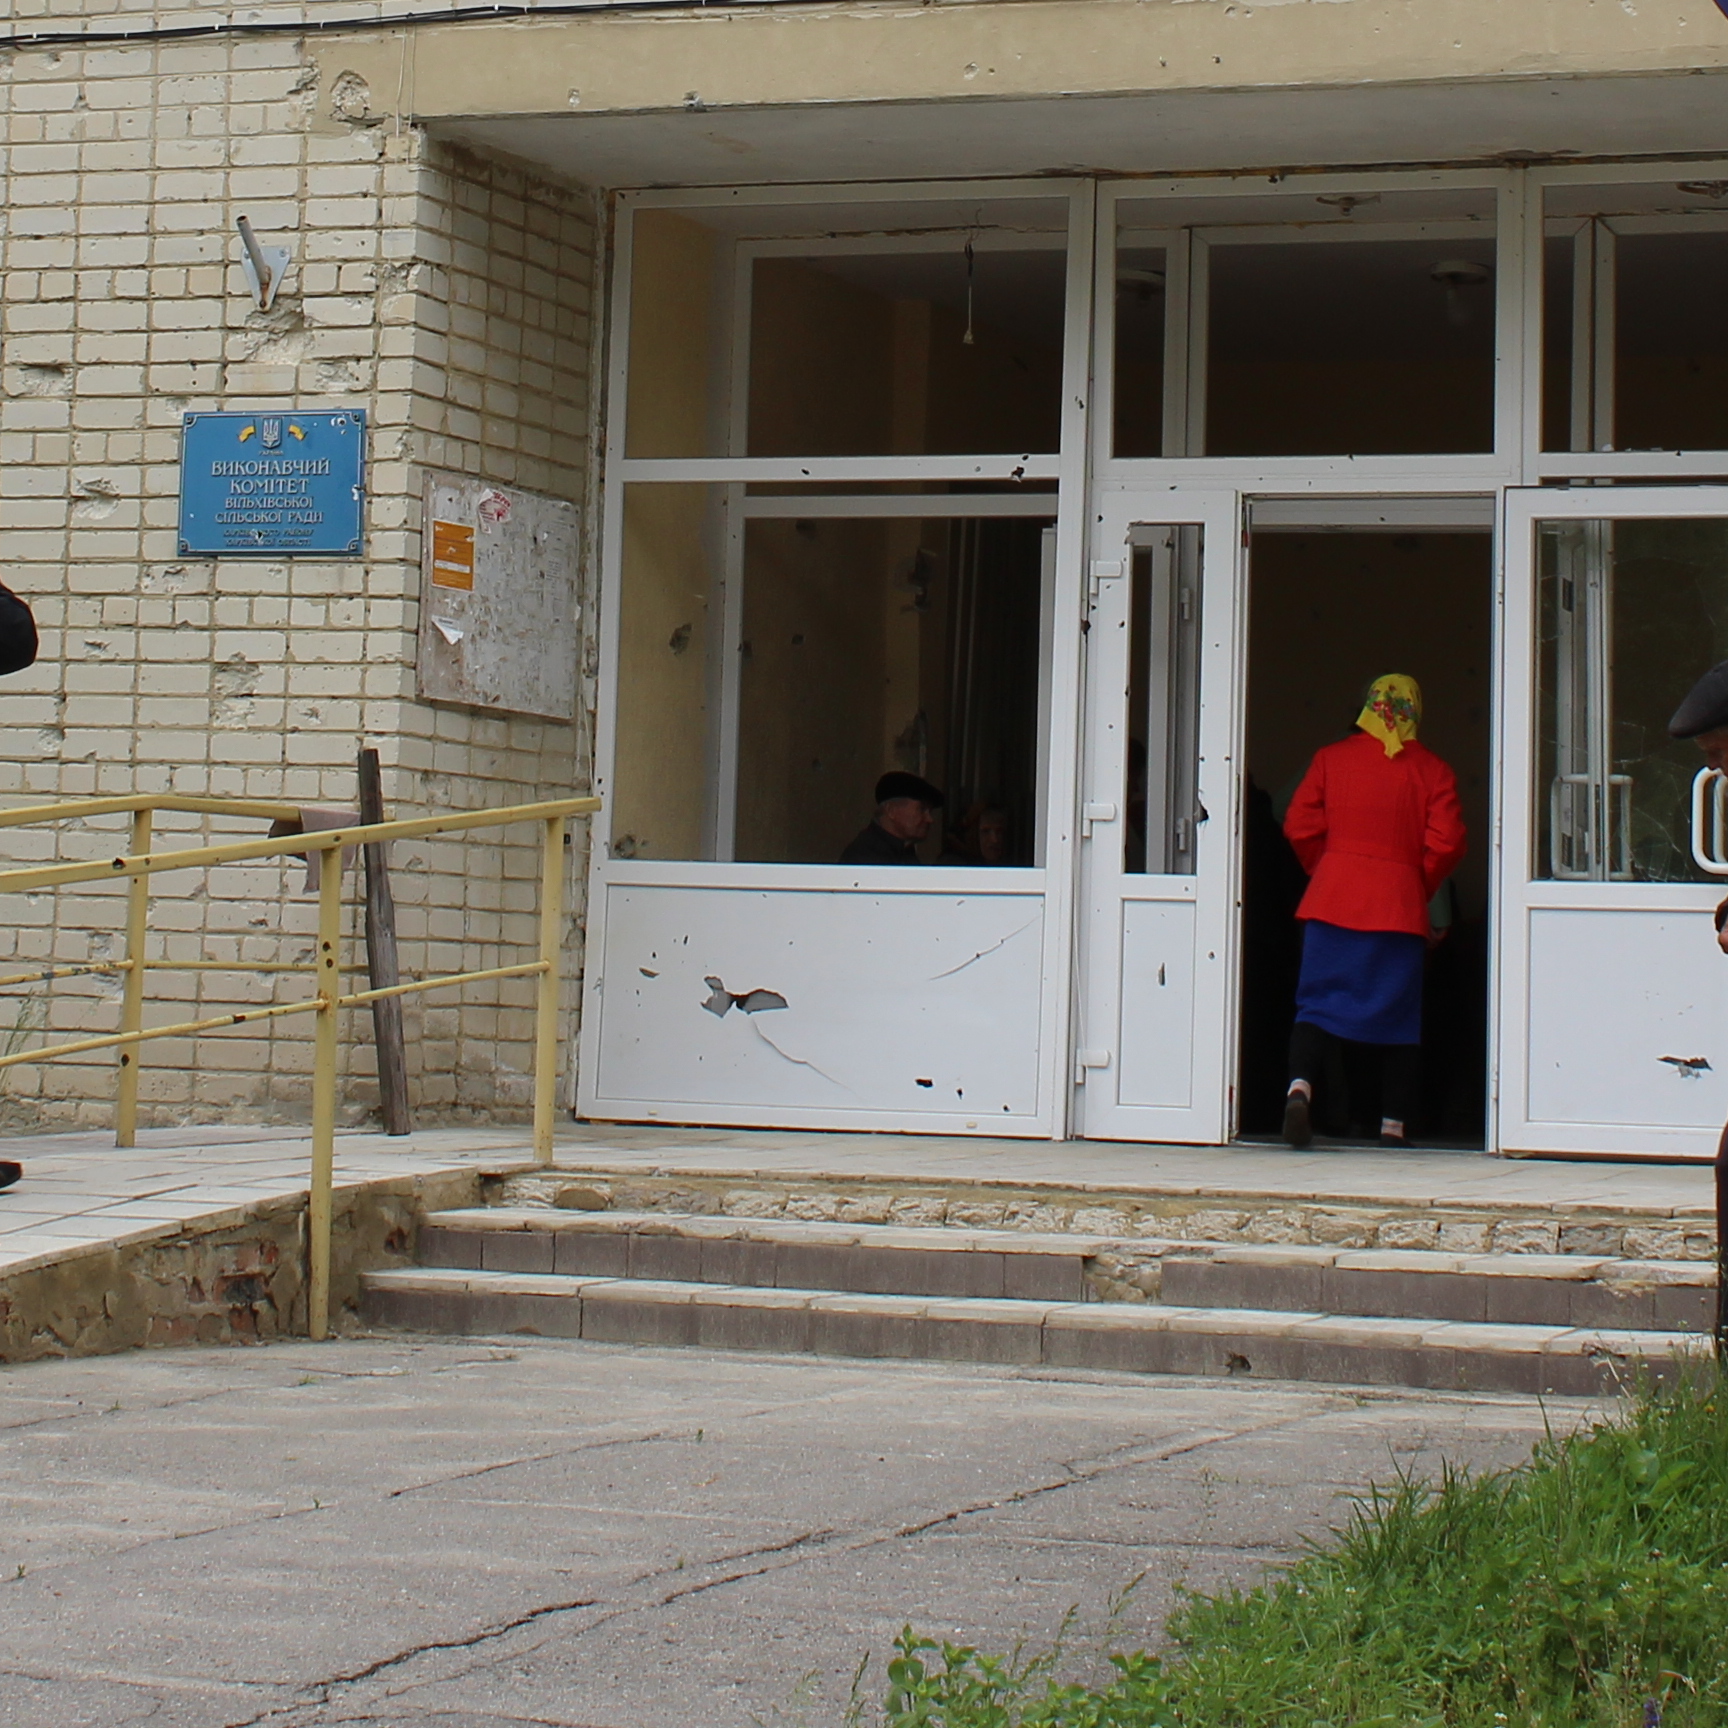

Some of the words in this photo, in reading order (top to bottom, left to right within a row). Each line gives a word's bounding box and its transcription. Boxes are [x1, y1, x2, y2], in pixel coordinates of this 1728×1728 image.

[211, 458, 331, 476] ВИКОНАВЧИЙ
[230, 478, 310, 494] КОМІТЕТ
[225, 496, 313, 509] ВІЛЬХІВСЬКОЇ
[215, 510, 283, 524] СІЛЬСЬКОЇ
[288, 511, 323, 525] РАДИ
